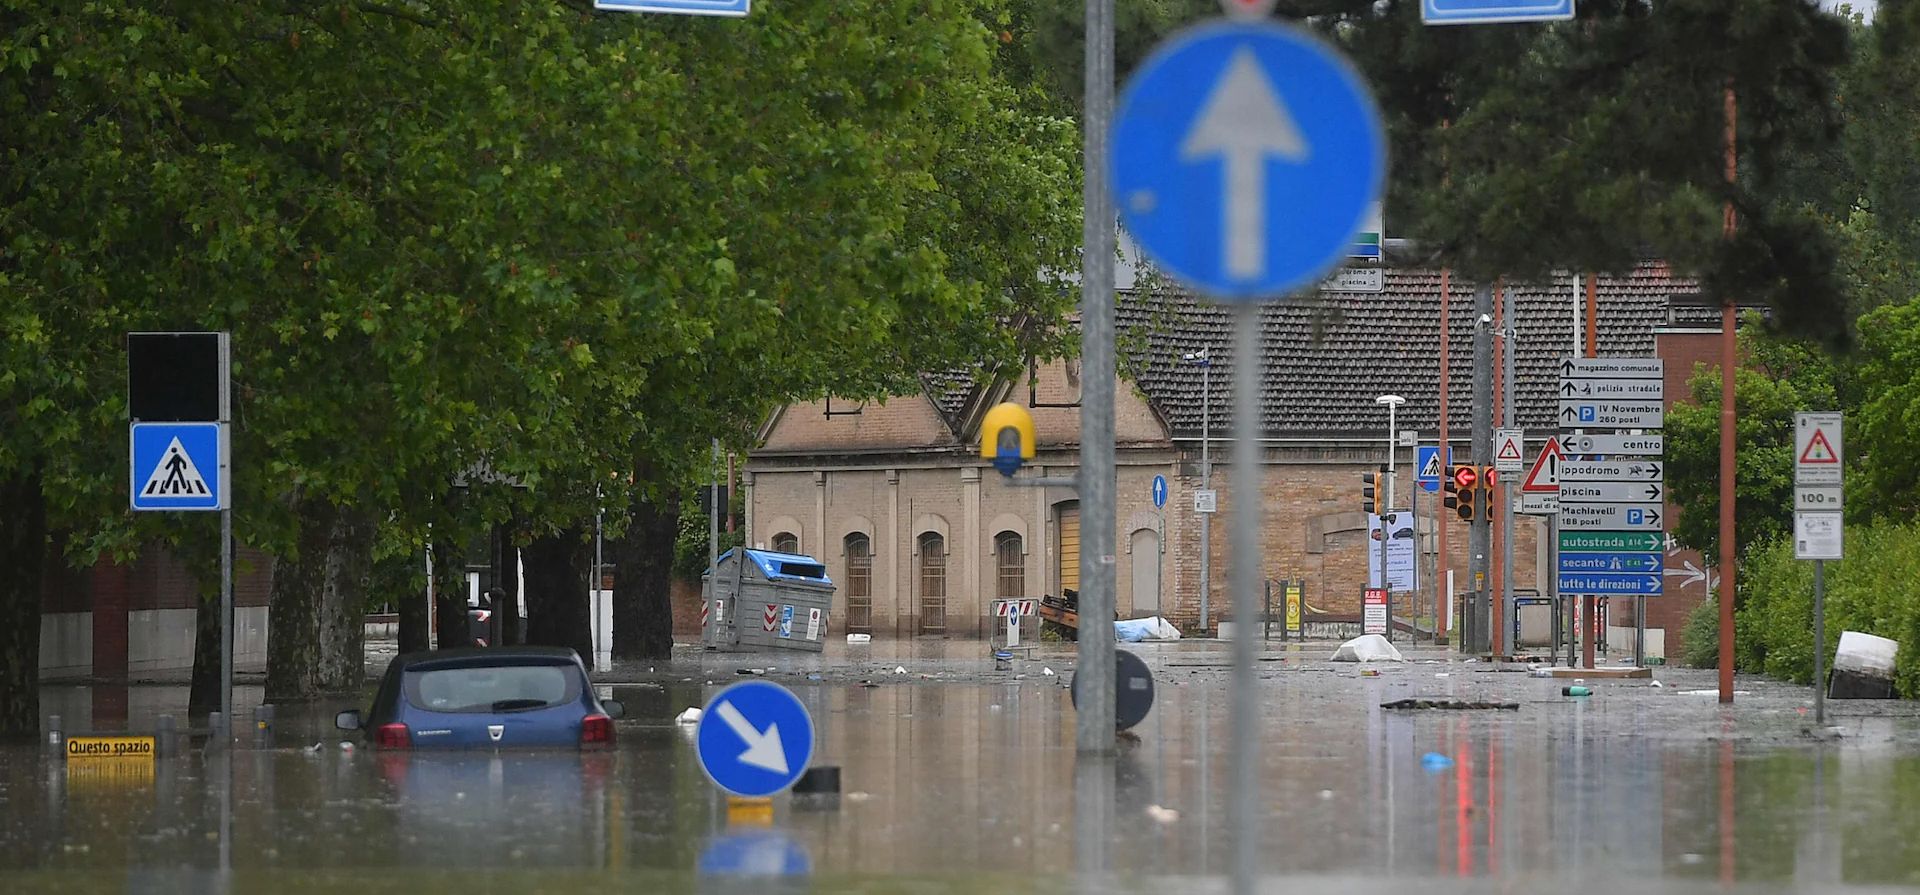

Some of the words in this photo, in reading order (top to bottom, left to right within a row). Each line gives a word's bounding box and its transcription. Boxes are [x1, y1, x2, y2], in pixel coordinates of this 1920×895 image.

[1578, 364, 1619, 373] magazzino
[1620, 364, 1660, 372] comunale
[1597, 384, 1623, 393] polizia
[1628, 384, 1661, 393] stradale
[1599, 405, 1609, 413] IV
[1612, 405, 1660, 413] Novembre
[1599, 416, 1616, 424] 260
[1618, 415, 1640, 424] posti
[1623, 440, 1661, 449] centro
[1561, 465, 1620, 475] ippodromo
[1561, 487, 1601, 498] piscina
[1801, 493, 1825, 503] 100
[1561, 506, 1616, 515] Machiavelli
[1580, 517, 1601, 527] posti
[1562, 537, 1625, 547] autostrada
[1628, 538, 1641, 546] A14
[1562, 558, 1606, 568] secante
[1559, 579, 1584, 589] tutte
[1586, 579, 1597, 589] le
[1598, 578, 1641, 589] direzioni
[69, 740, 110, 754] Questo
[114, 739, 150, 756] spazio
